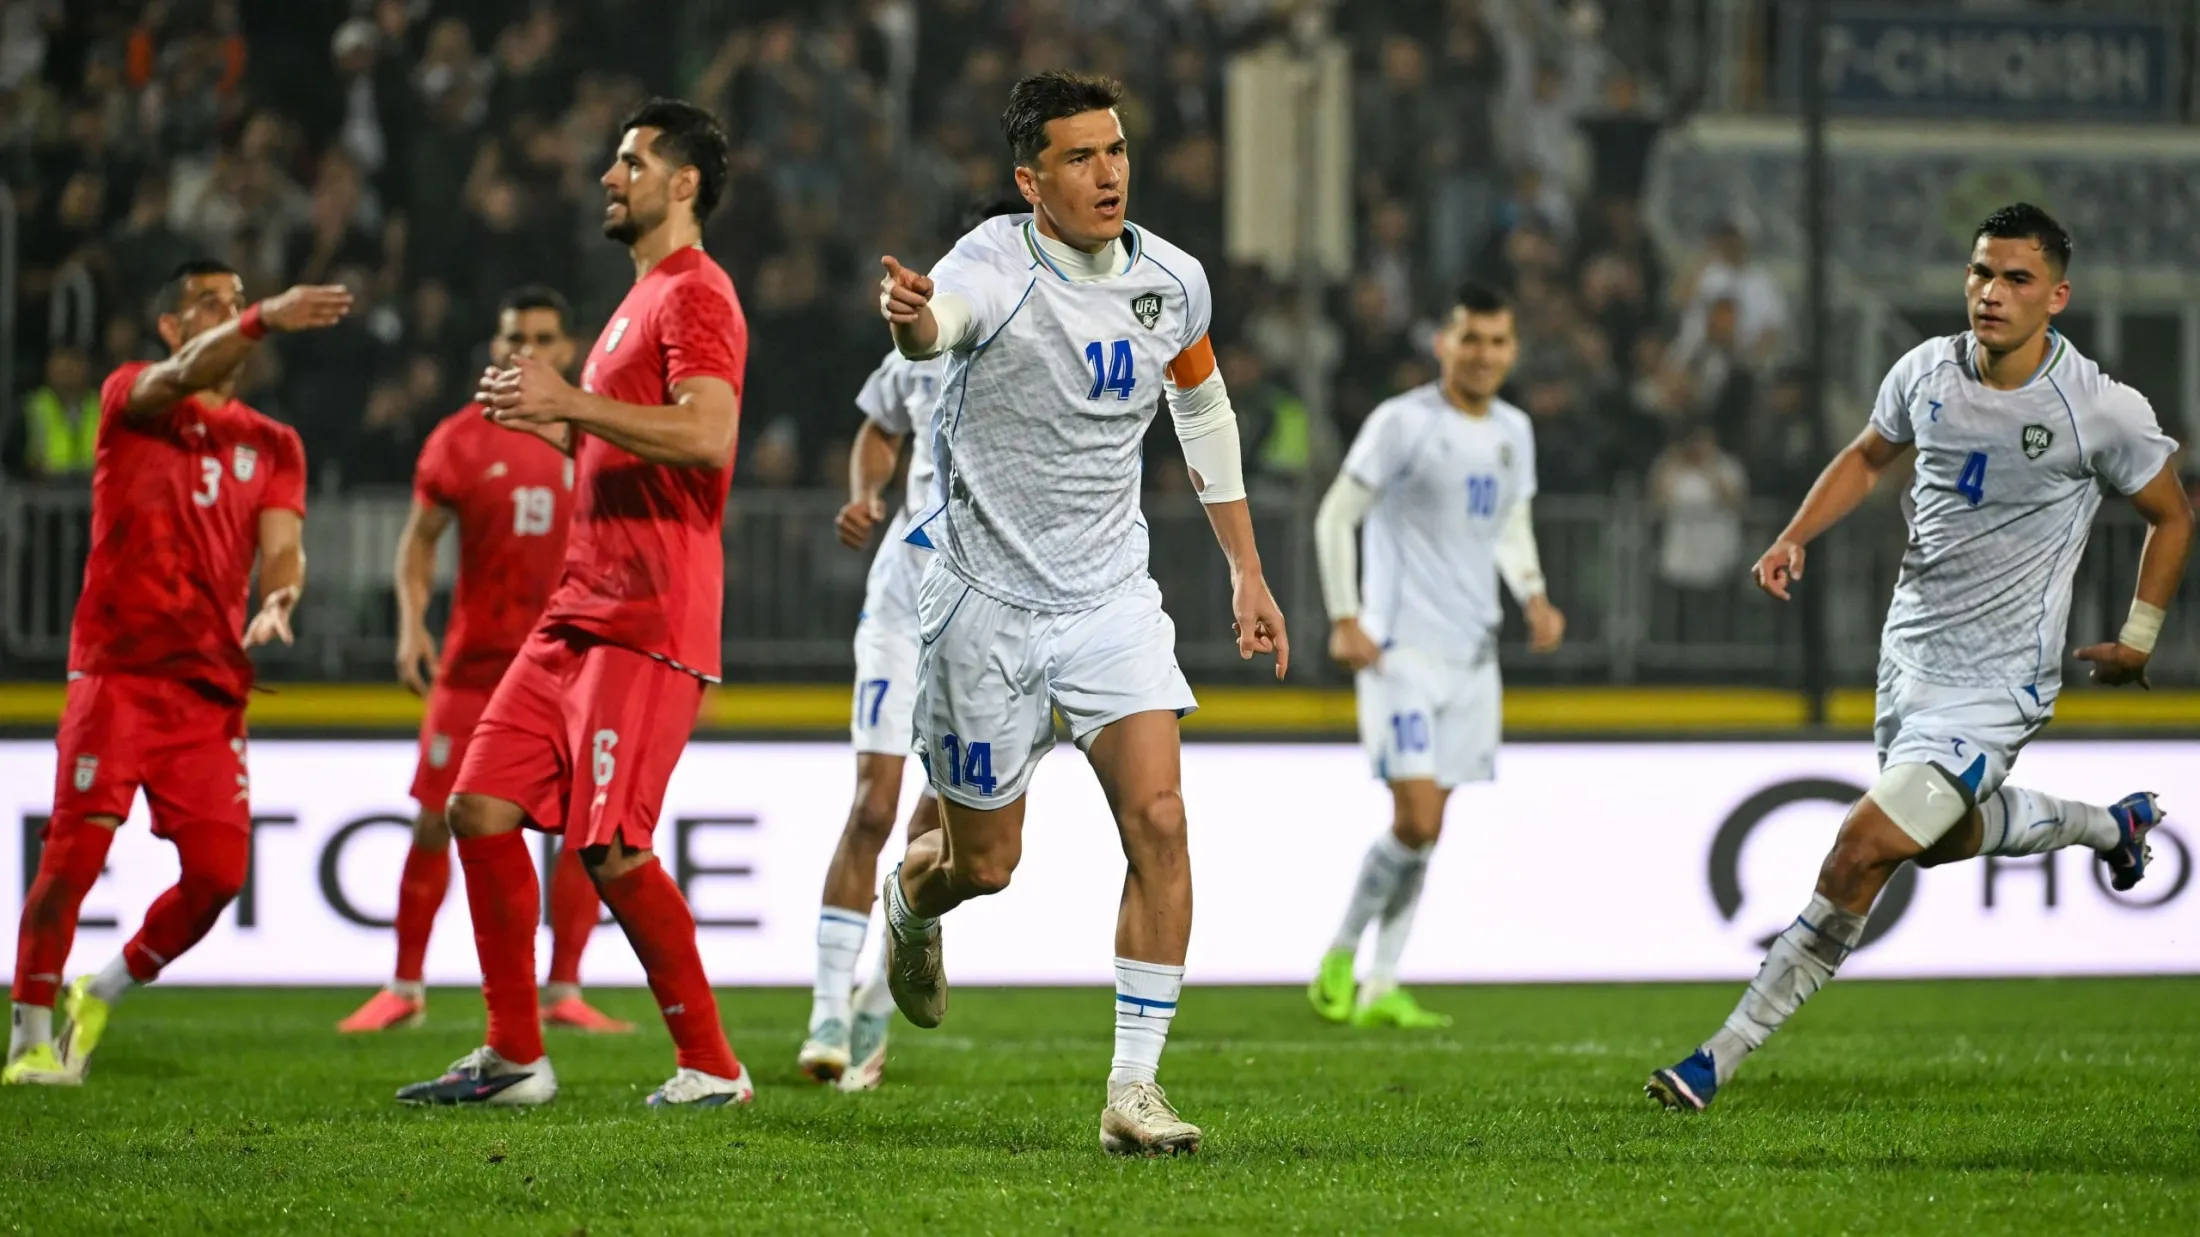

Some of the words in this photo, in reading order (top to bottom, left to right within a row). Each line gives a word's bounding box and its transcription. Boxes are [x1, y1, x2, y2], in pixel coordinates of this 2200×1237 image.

[1136, 299, 1158, 313] UFA
[1085, 339, 1136, 400] 14
[2024, 426, 2048, 446] UFA
[192, 456, 222, 508] 3
[1466, 474, 1498, 518] 10
[1955, 451, 1988, 507] 4
[511, 486, 555, 537] 19
[858, 679, 890, 729] 17
[593, 729, 619, 786] 6
[1391, 711, 1429, 753] 10
[942, 734, 997, 796] 14
